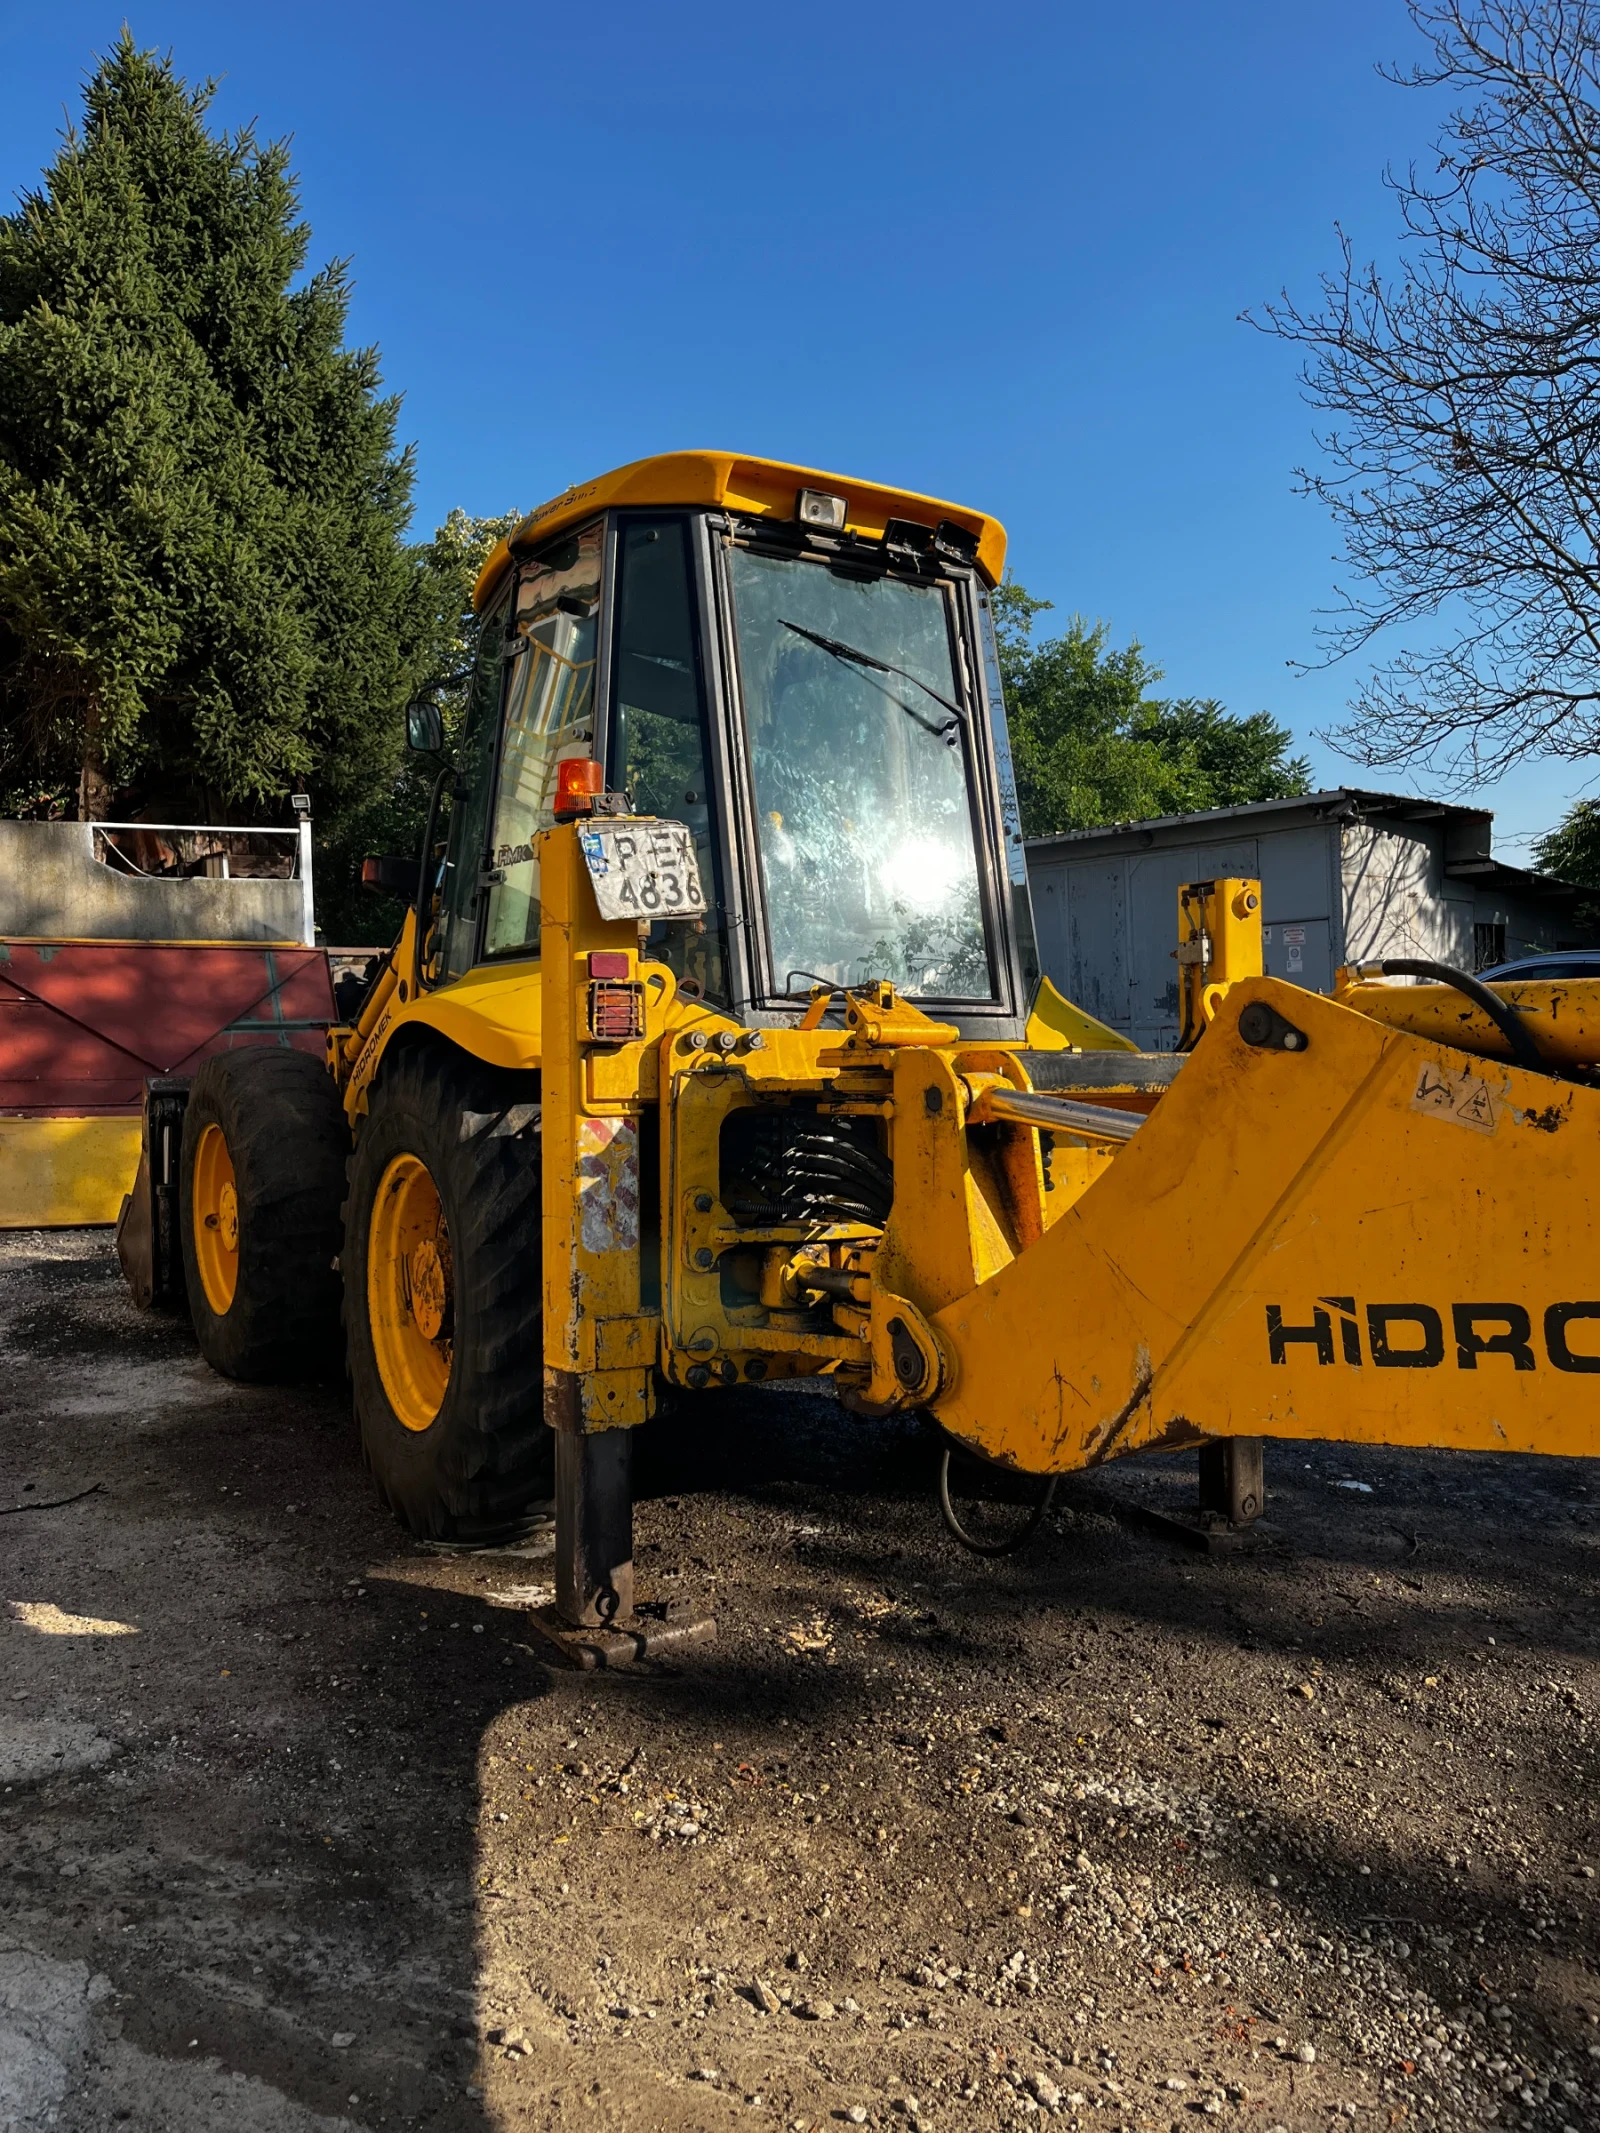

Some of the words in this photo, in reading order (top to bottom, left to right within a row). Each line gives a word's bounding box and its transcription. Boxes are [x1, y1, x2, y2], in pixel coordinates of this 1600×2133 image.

[497, 844, 527, 868] HMK
[615, 837, 637, 872] P
[619, 873, 701, 909] 4836
